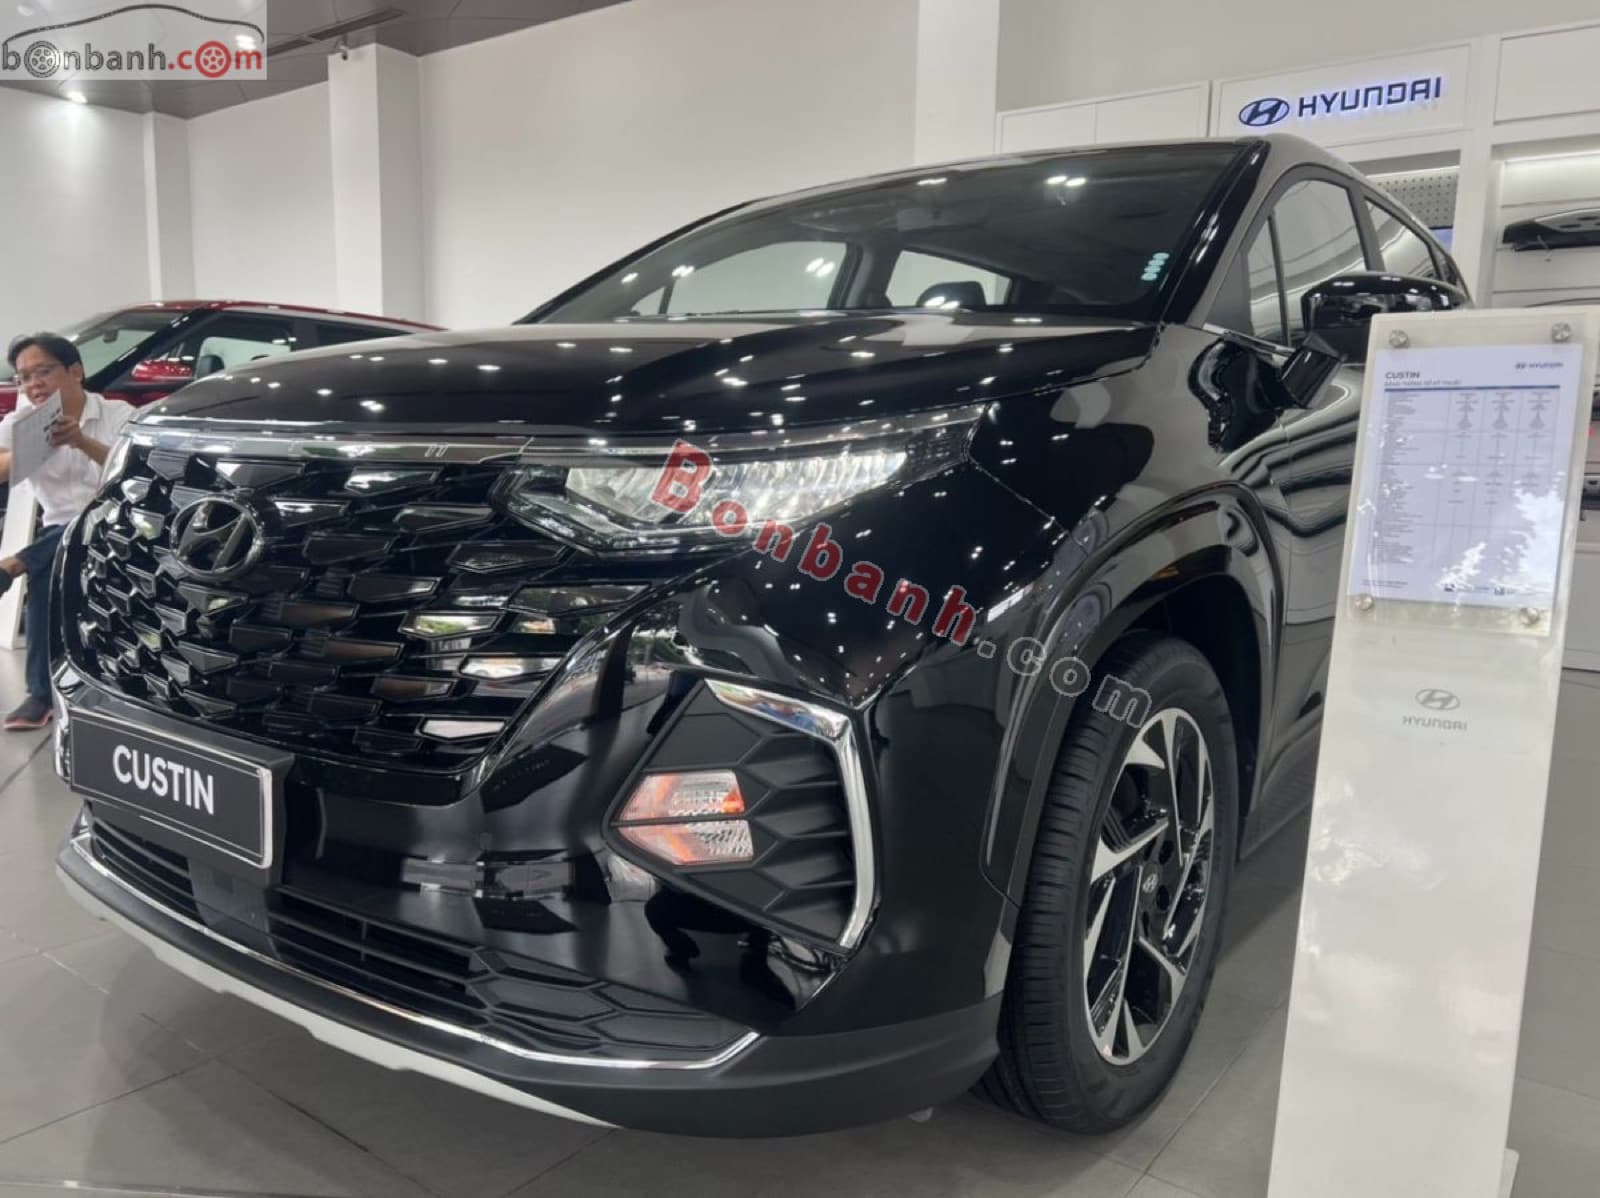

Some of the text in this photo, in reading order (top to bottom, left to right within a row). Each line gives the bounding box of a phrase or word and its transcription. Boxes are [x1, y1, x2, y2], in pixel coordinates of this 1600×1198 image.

[1298, 77, 1442, 117] HYUNDAI
[1402, 715, 1468, 731] HYUNDAI
[112, 745, 214, 815] CUSTIN
